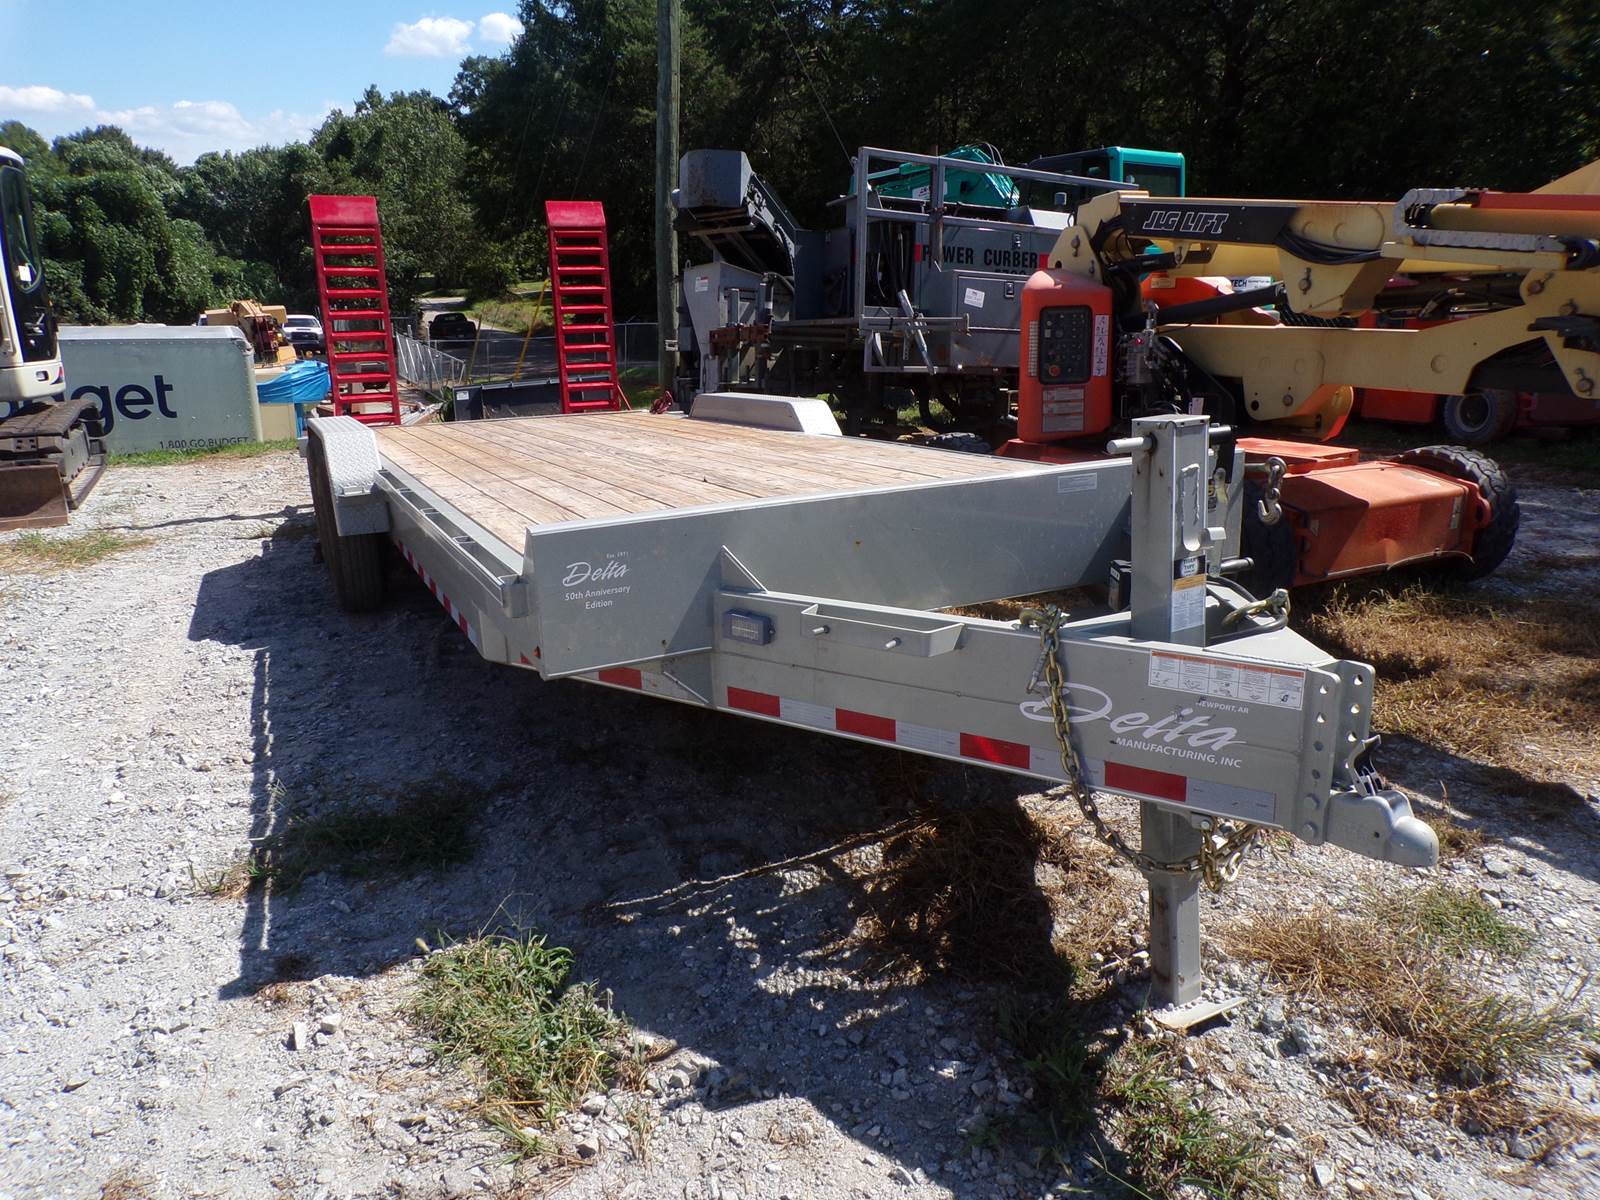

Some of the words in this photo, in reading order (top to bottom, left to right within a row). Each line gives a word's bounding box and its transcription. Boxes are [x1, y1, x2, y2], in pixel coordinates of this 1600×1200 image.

[1143, 210, 1181, 231] JLG
[1180, 211, 1229, 234] LIFT
[923, 244, 974, 265] PWER
[984, 248, 1038, 269] CURBER
[562, 560, 630, 587] Delta
[564, 591, 584, 601] 50th
[584, 585, 631, 598] Anniversary
[585, 599, 613, 610] Edition
[1019, 681, 1247, 751] Delta
[1115, 736, 1218, 766] MANUFACTURING,
[1220, 756, 1242, 769] INC
